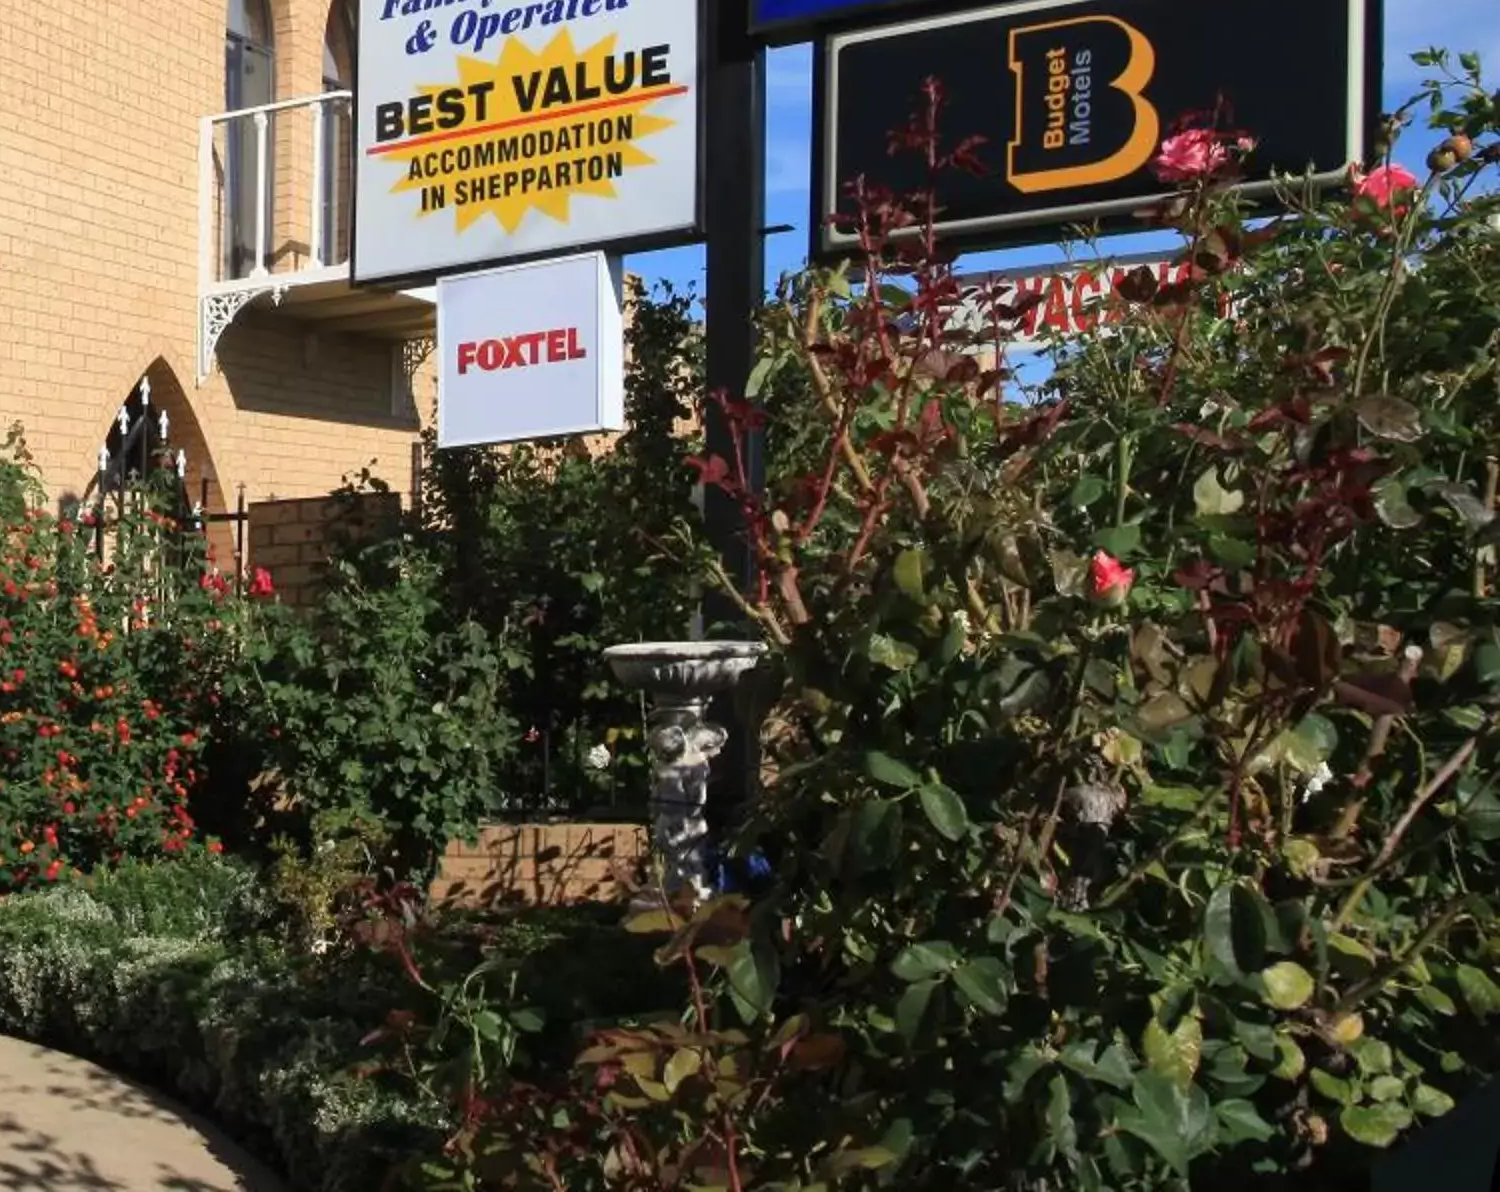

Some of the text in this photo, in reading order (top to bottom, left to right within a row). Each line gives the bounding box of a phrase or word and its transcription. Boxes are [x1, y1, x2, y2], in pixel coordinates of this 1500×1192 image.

[405, 20, 437, 56] &
[376, 43, 671, 143] BEST VALUE
[1043, 47, 1071, 150] Budget
[1069, 49, 1092, 146] Motels
[408, 114, 634, 181] ACCOMMODATION
[421, 151, 623, 212] IN SHEPPARTON
[457, 327, 587, 375] FOXTEL
